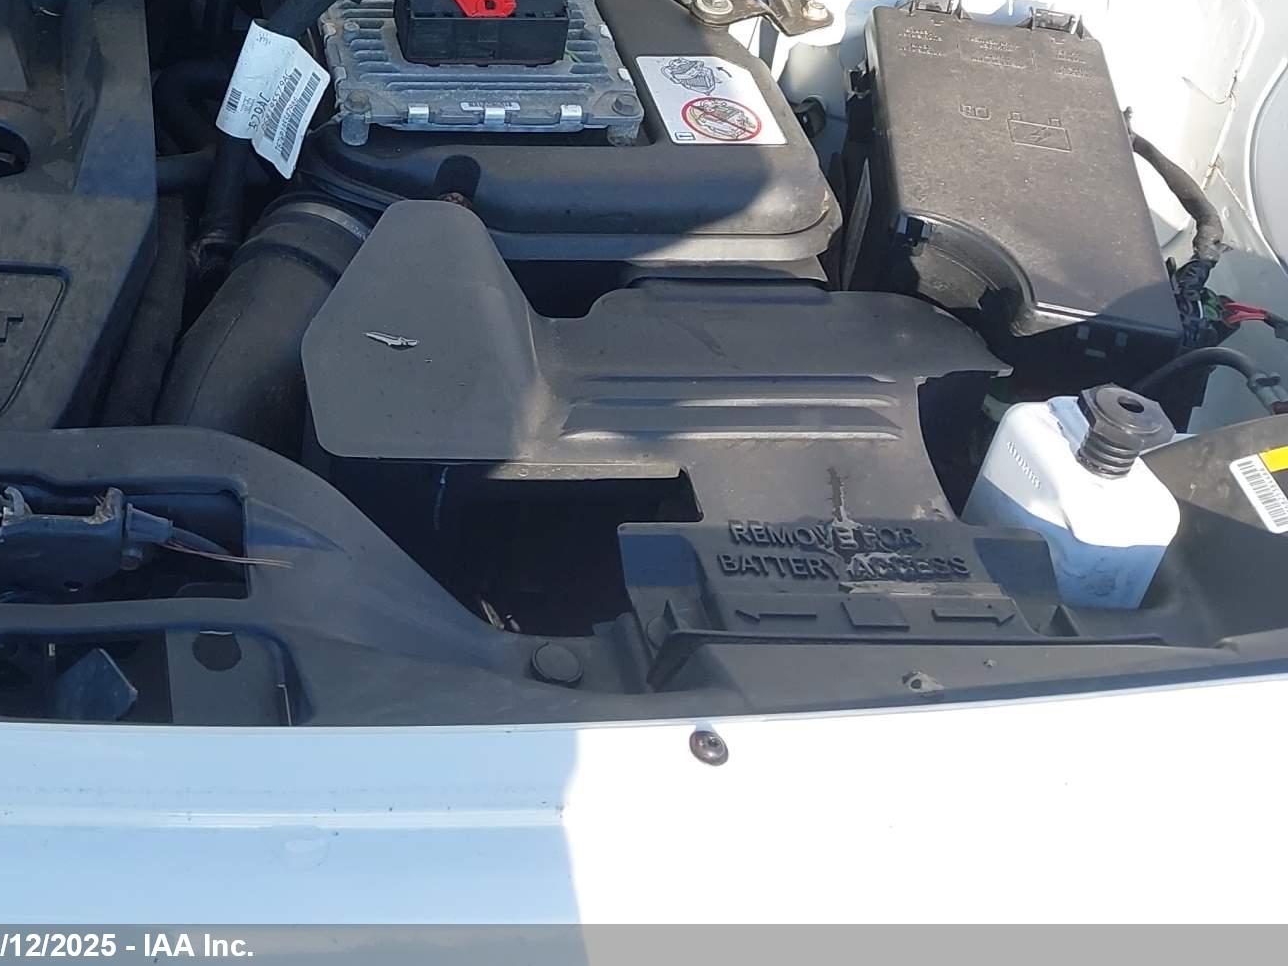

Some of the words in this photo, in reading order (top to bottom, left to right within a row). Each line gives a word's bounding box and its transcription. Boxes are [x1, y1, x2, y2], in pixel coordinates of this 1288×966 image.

[729, 520, 859, 550] REMOVE
[864, 526, 922, 552] FOR
[718, 553, 840, 580] BATTERY
[847, 553, 971, 581] ACCESS
